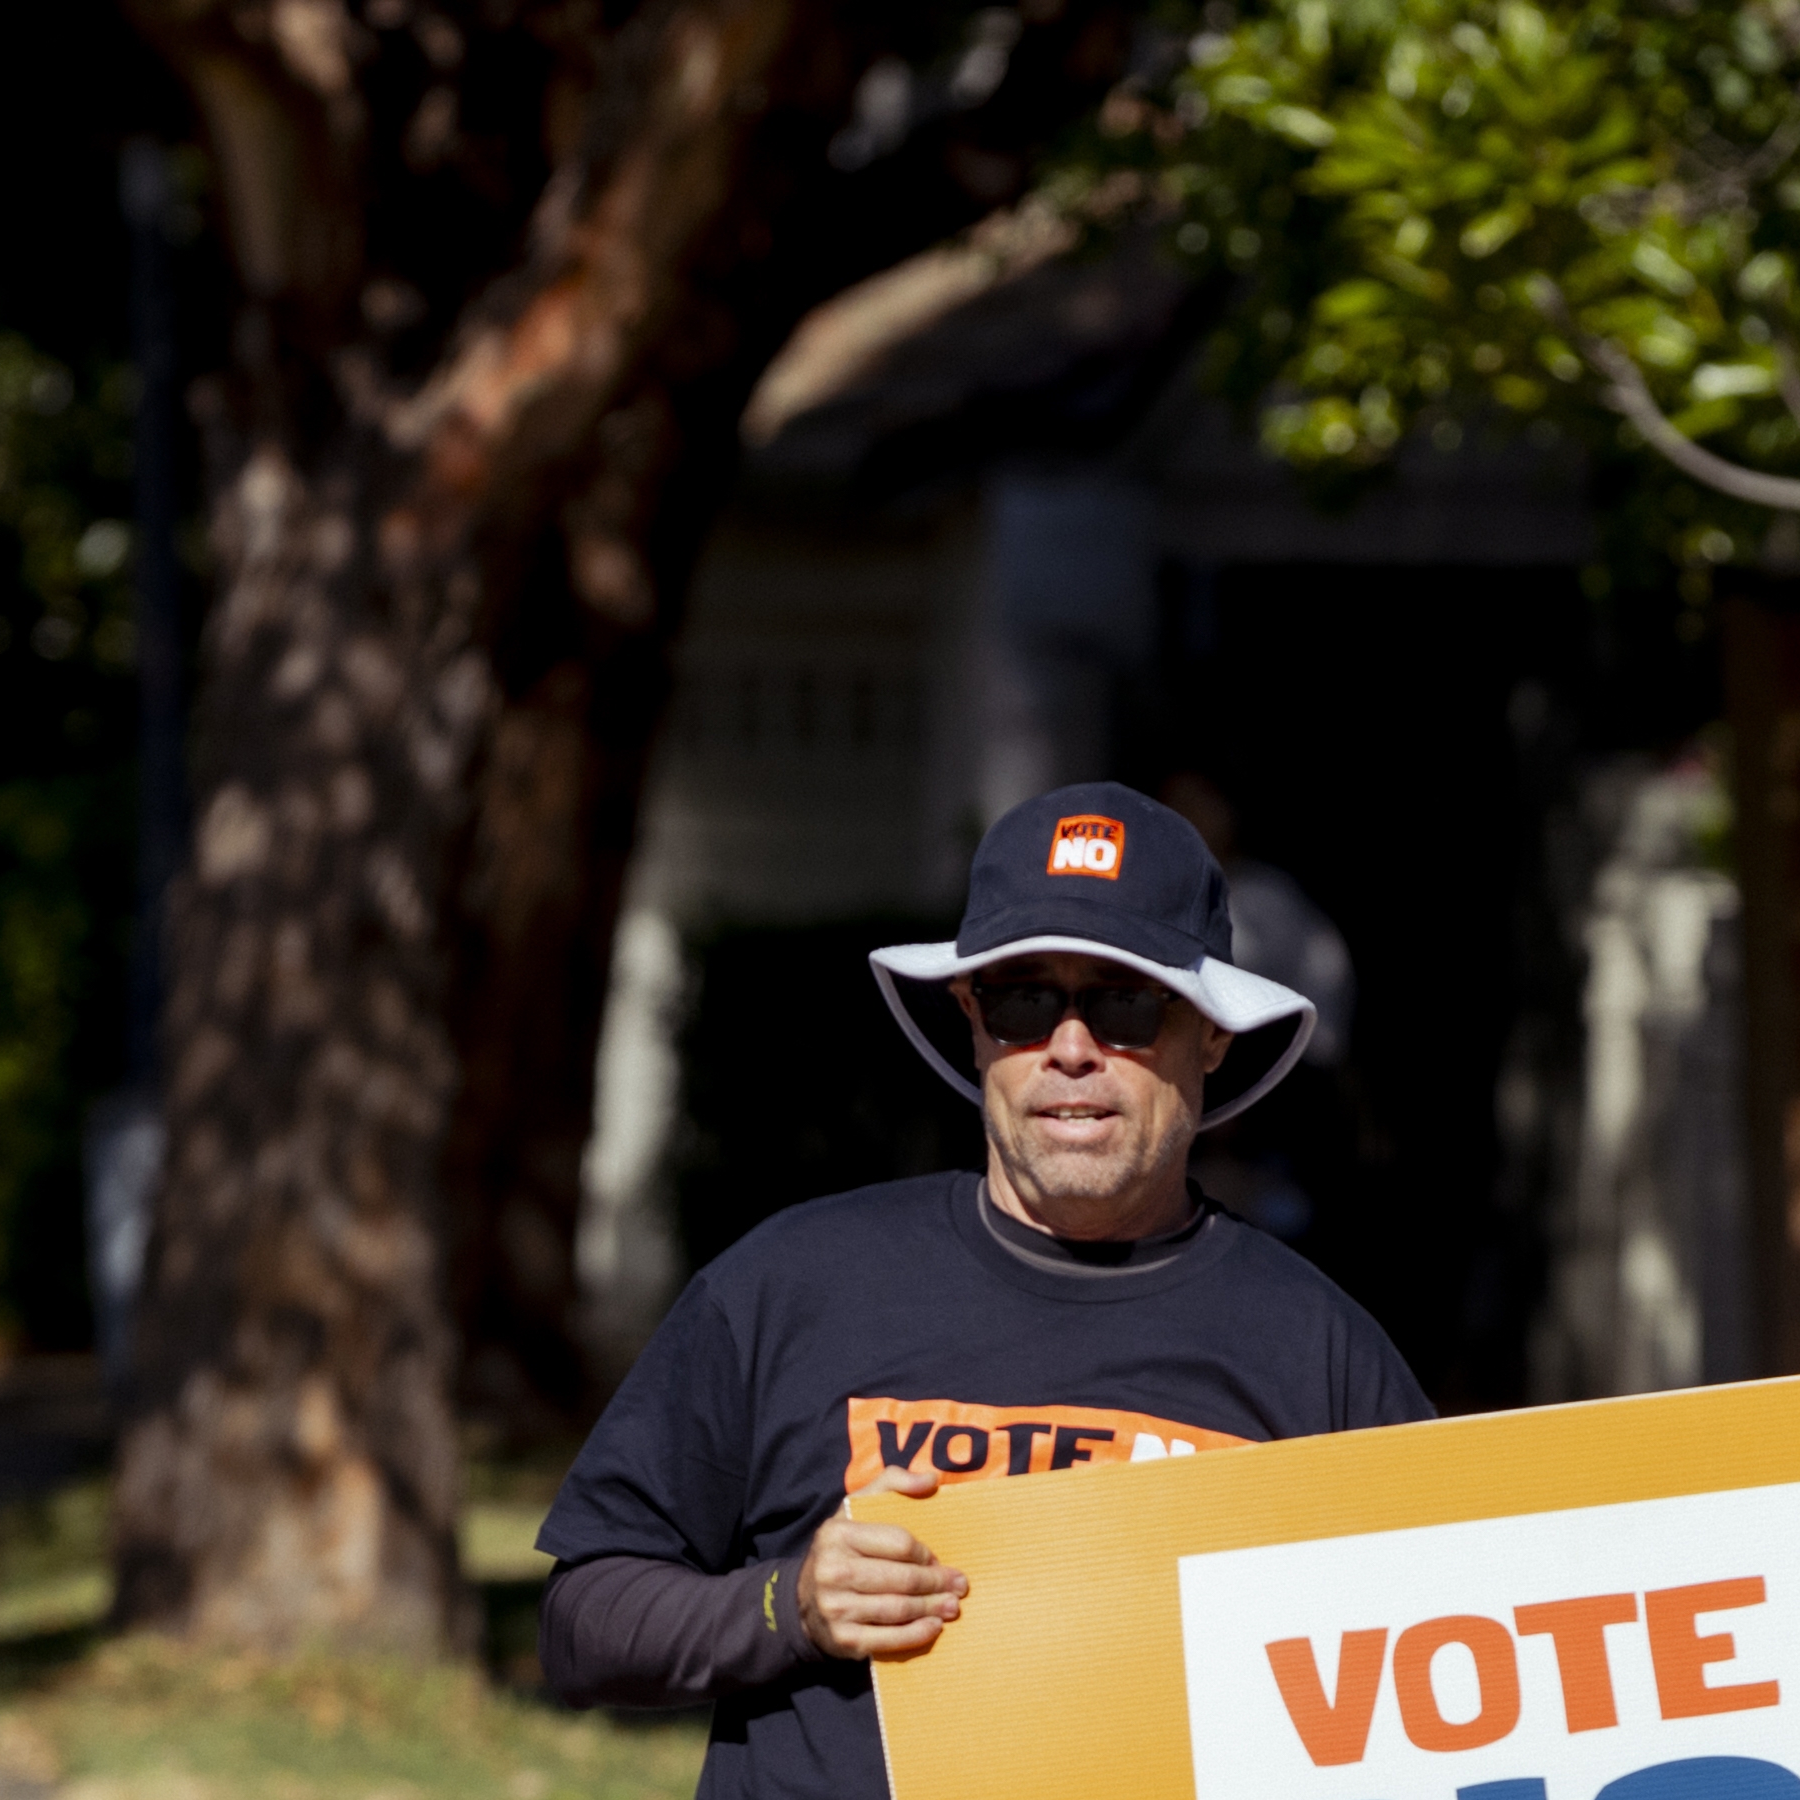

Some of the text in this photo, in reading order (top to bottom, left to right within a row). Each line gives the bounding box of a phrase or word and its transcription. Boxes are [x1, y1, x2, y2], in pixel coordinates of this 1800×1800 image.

[1053, 836, 1118, 871] NO
[1061, 823, 1119, 840] VOTE
[875, 1420, 1116, 1477] VOTE
[1265, 1575, 1781, 1767] VOTE
